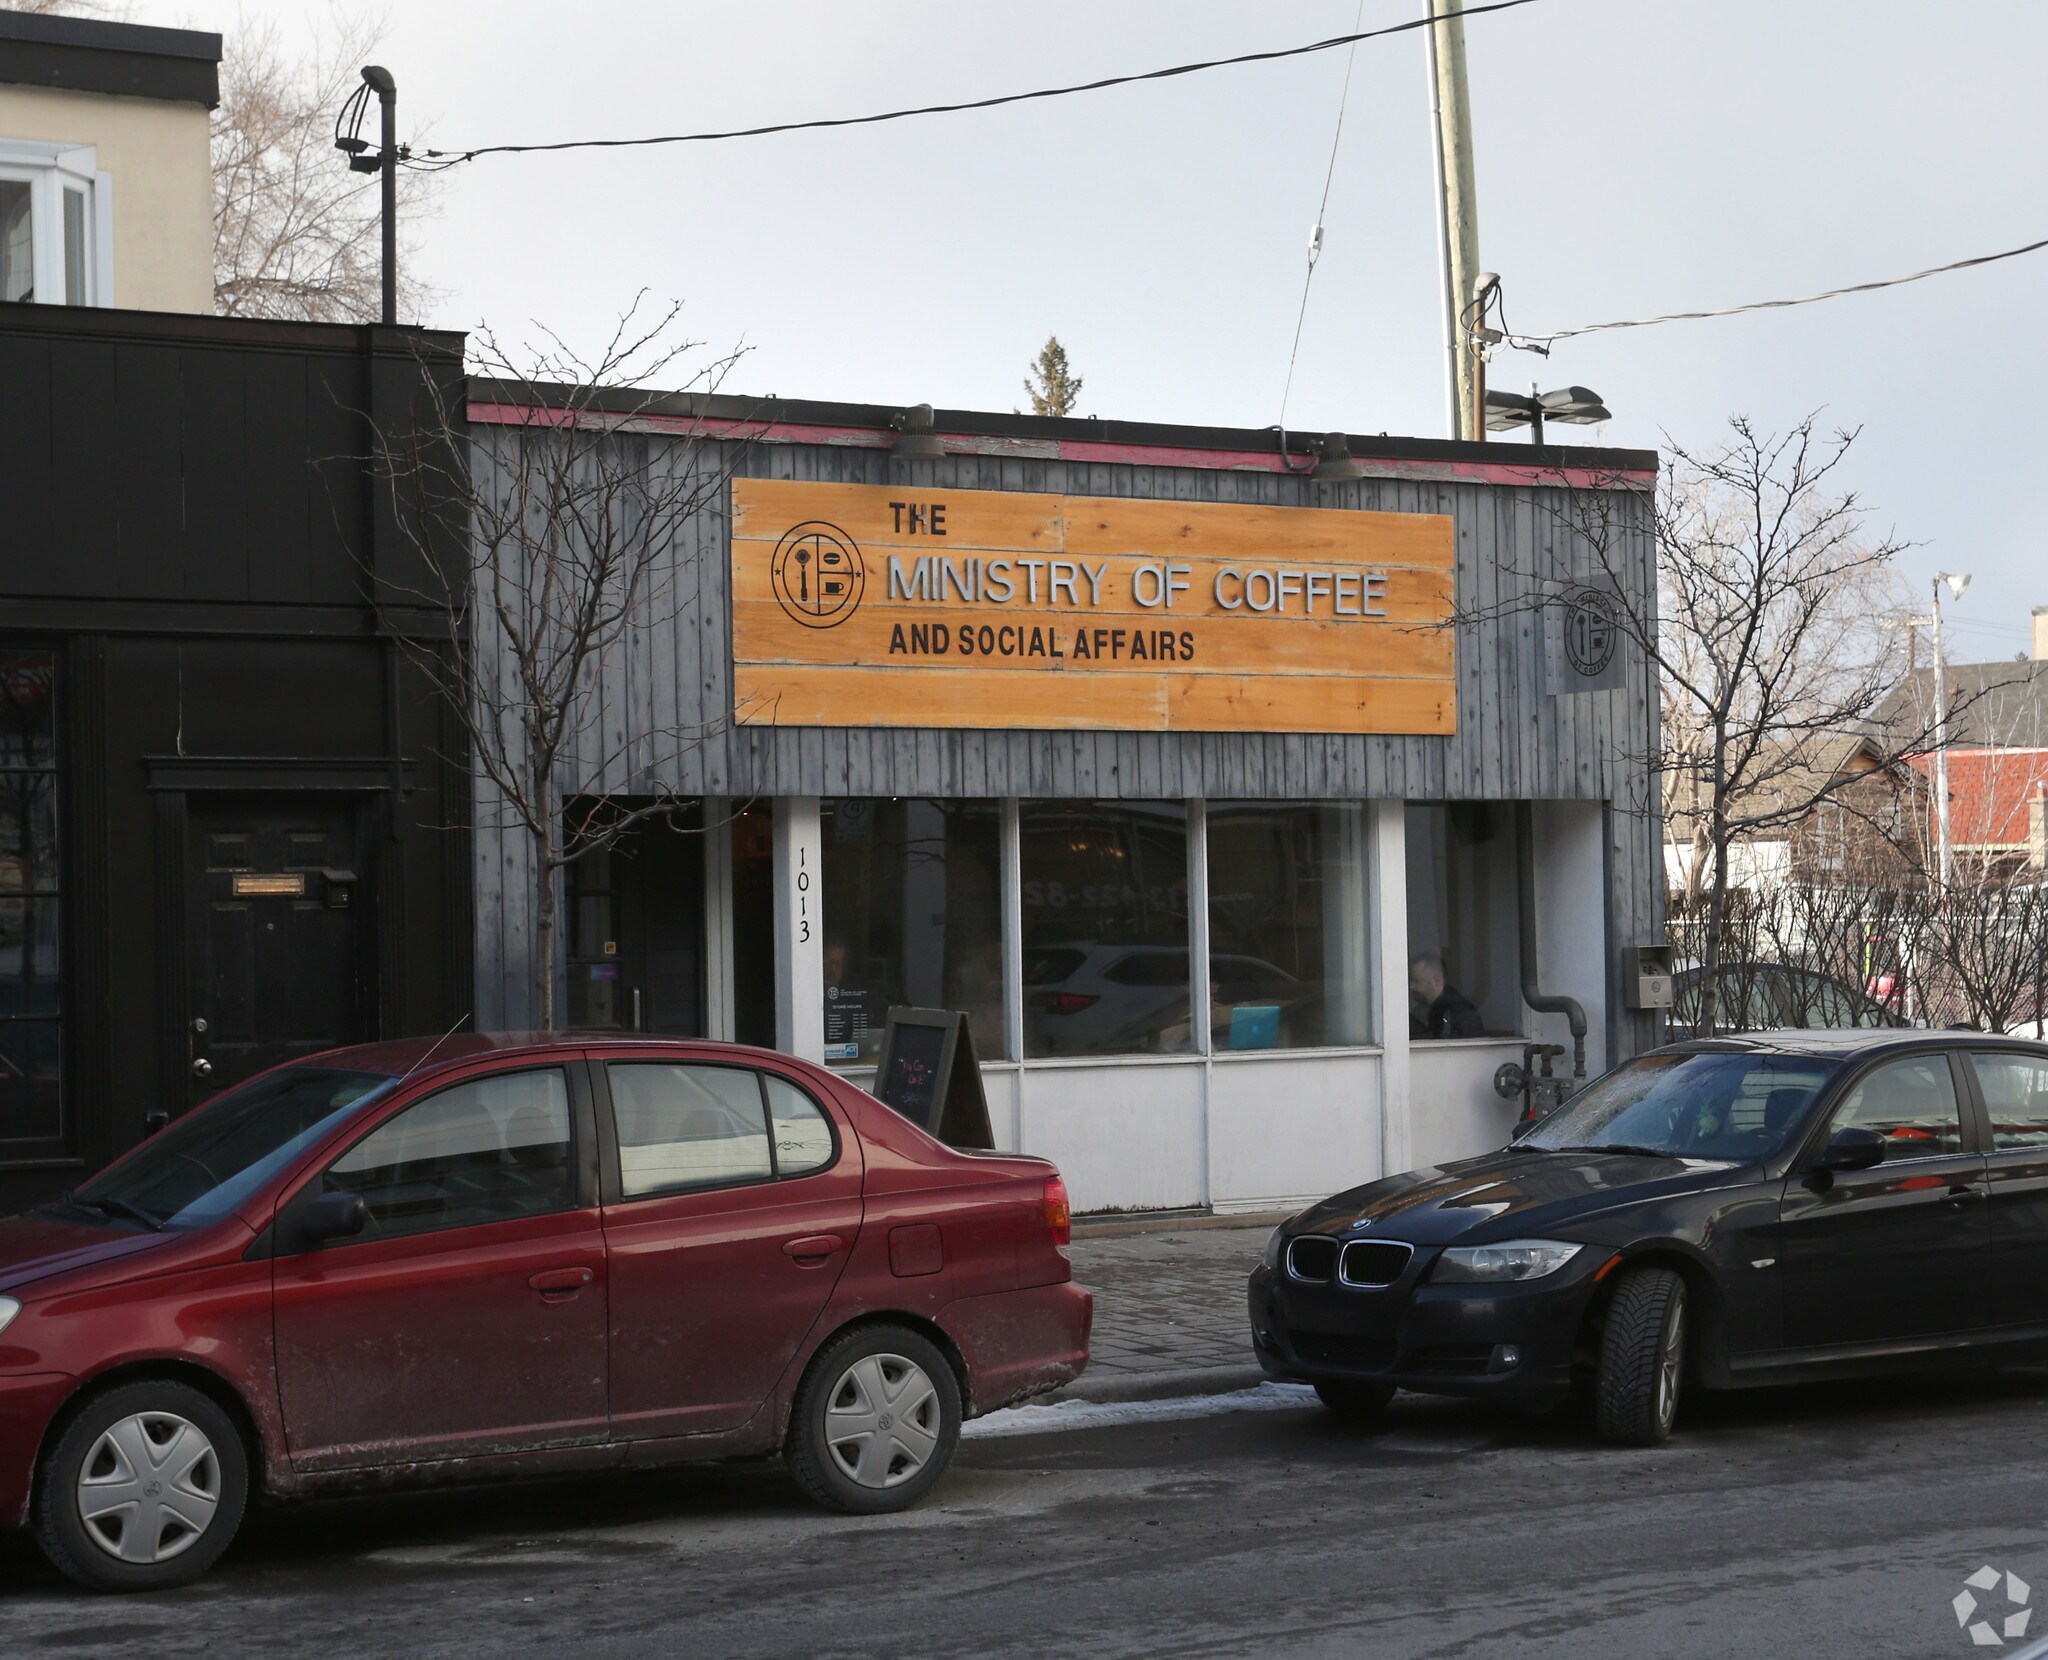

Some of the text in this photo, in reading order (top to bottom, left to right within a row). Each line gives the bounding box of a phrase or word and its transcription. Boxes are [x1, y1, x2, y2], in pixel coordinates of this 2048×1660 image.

[889, 502, 946, 535] THE
[888, 555, 1388, 615] MINISTRY OF COFFEE
[889, 623, 1194, 661] AND SOCIAL AFFAIRS
[798, 847, 810, 943] 1013
